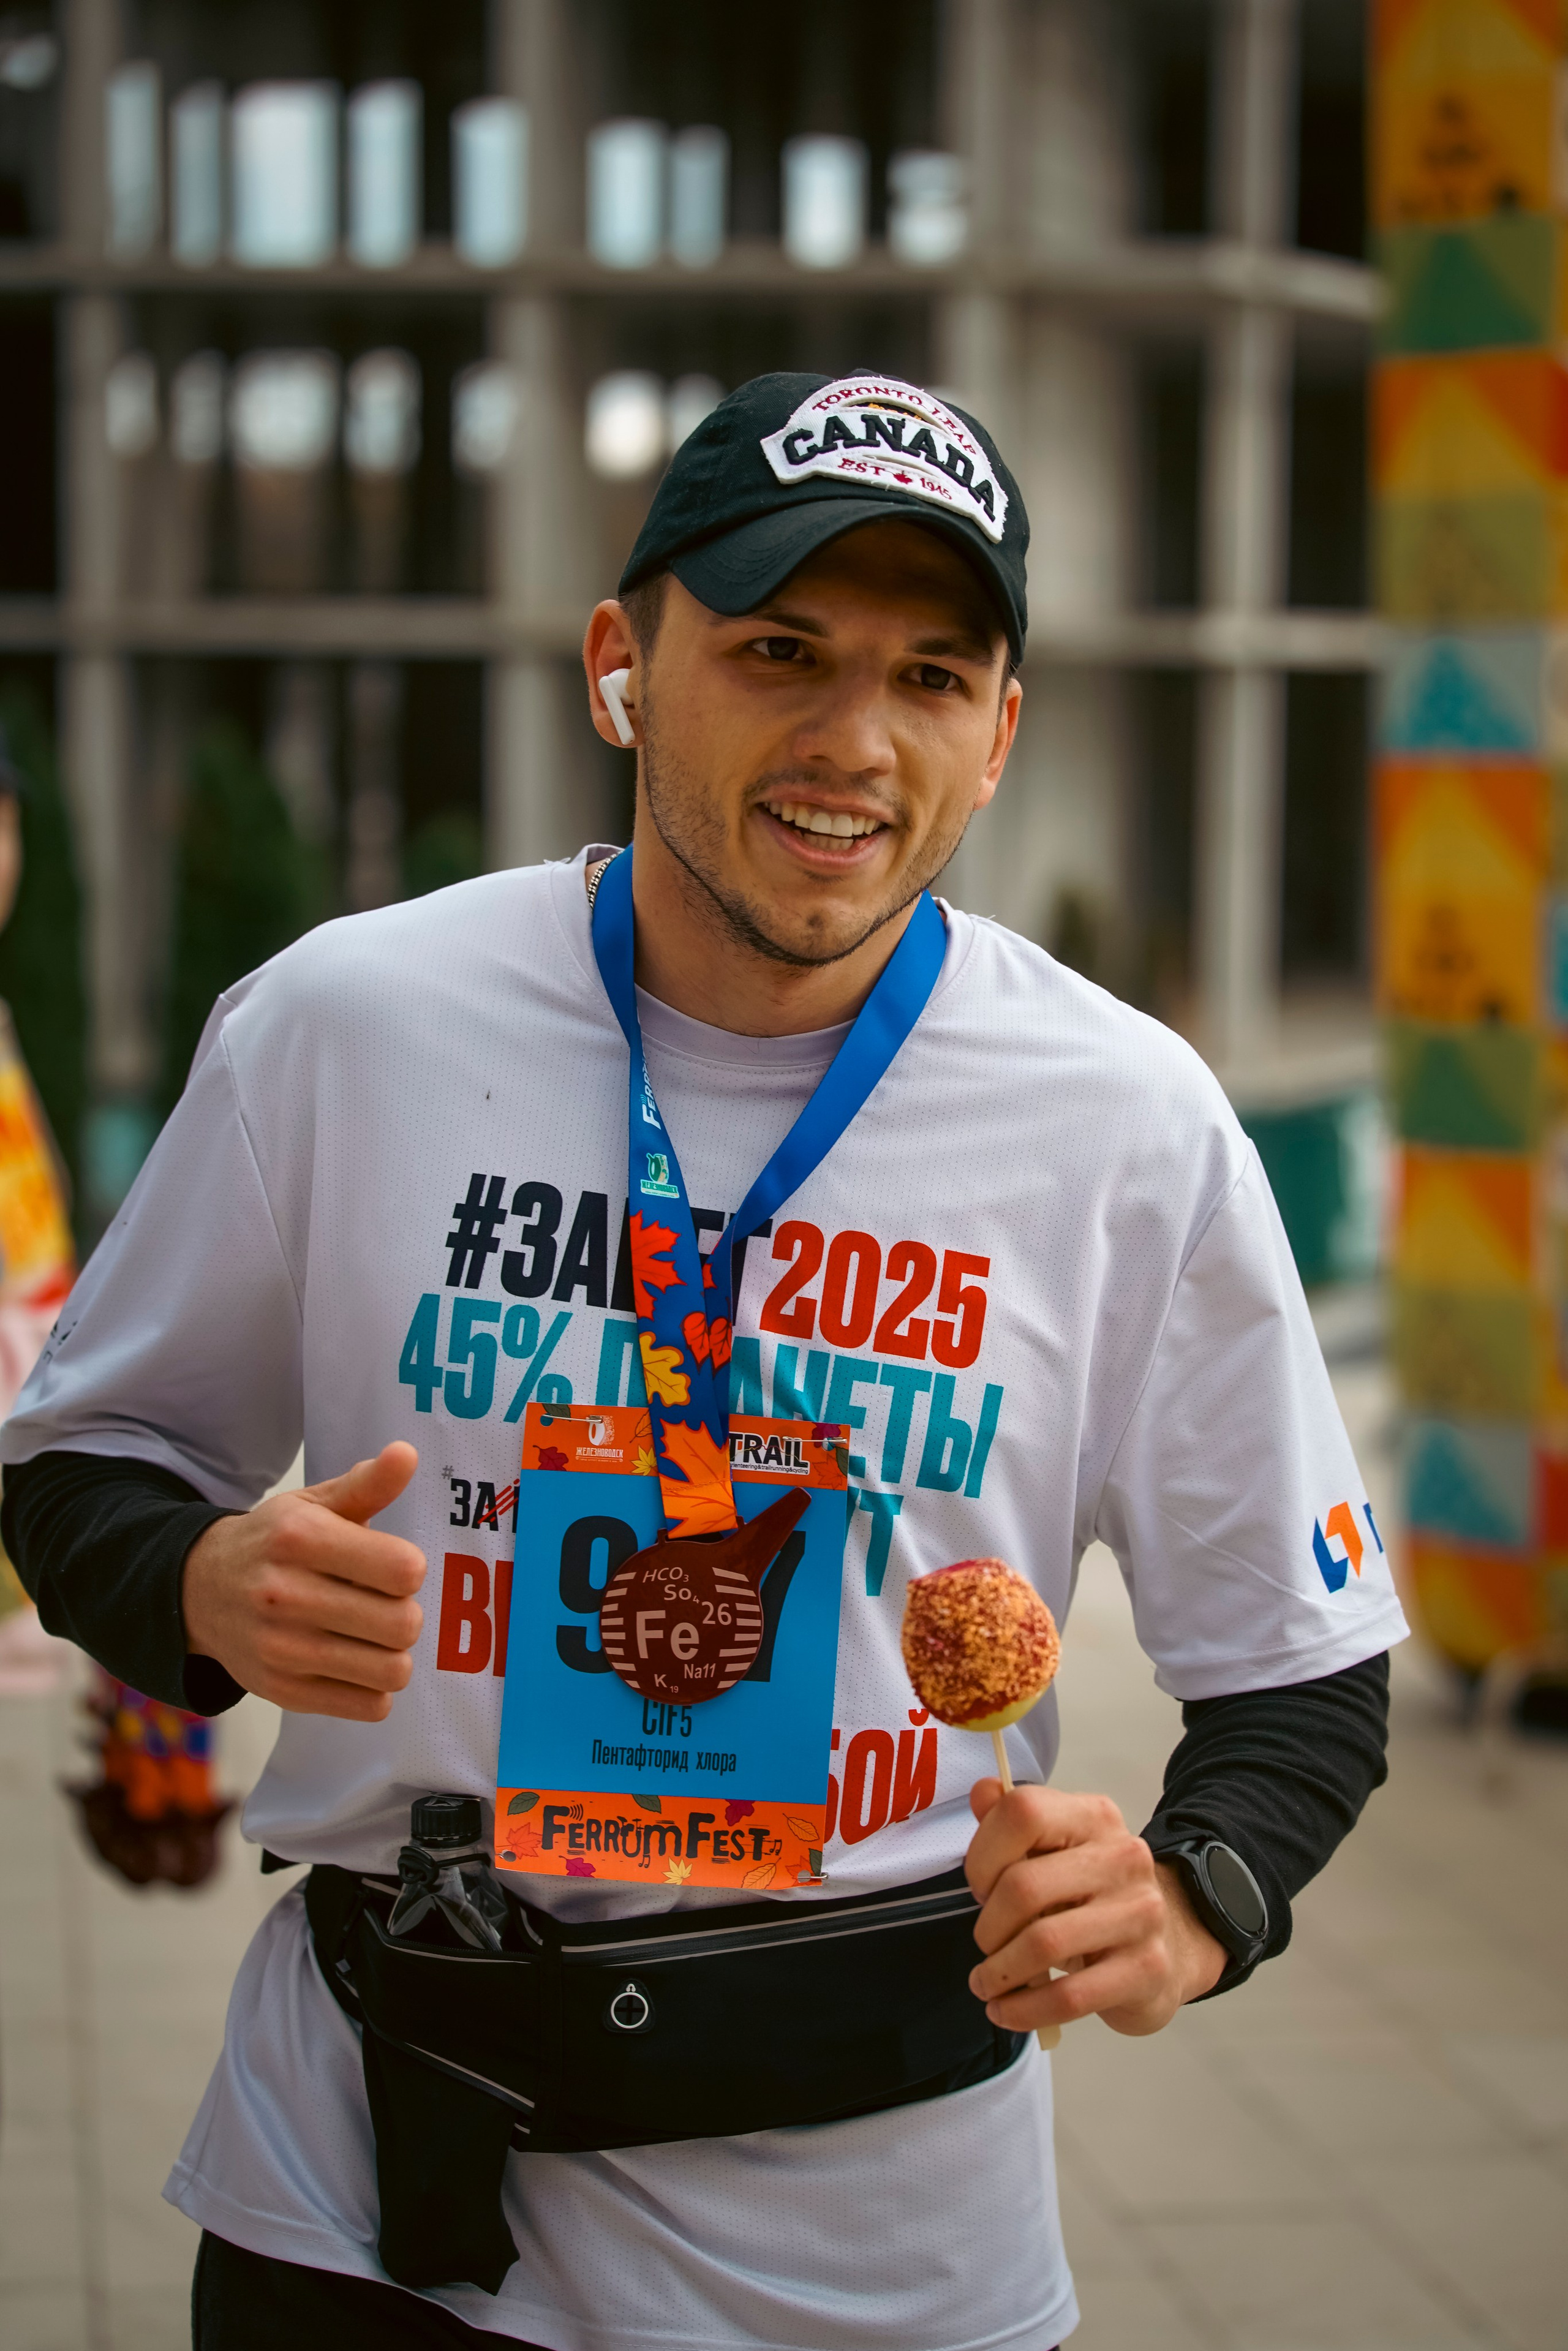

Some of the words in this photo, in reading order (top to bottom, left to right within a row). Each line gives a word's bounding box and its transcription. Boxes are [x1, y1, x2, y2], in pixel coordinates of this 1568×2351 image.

[812, 386, 924, 412] TORONTO
[782, 413, 996, 523] CANADA
[838, 458, 885, 476] EST
[920, 477, 952, 500] 1945
[399, 1293, 573, 1424] 45%
[595, 1317, 1005, 1499] ПАНЕТЫ
[576, 1447, 624, 1458] ЖЕЛЕЗНОВОДСК
[730, 1463, 809, 1474] rienteering&trailrunning&cycling
[556, 1515, 806, 1683] 97
[701, 1601, 733, 1626] 26
[636, 1610, 700, 1661] Fe
[684, 1663, 717, 1680] Na11
[592, 1739, 689, 1773] Пентафторид
[696, 1751, 737, 1776] хлора
